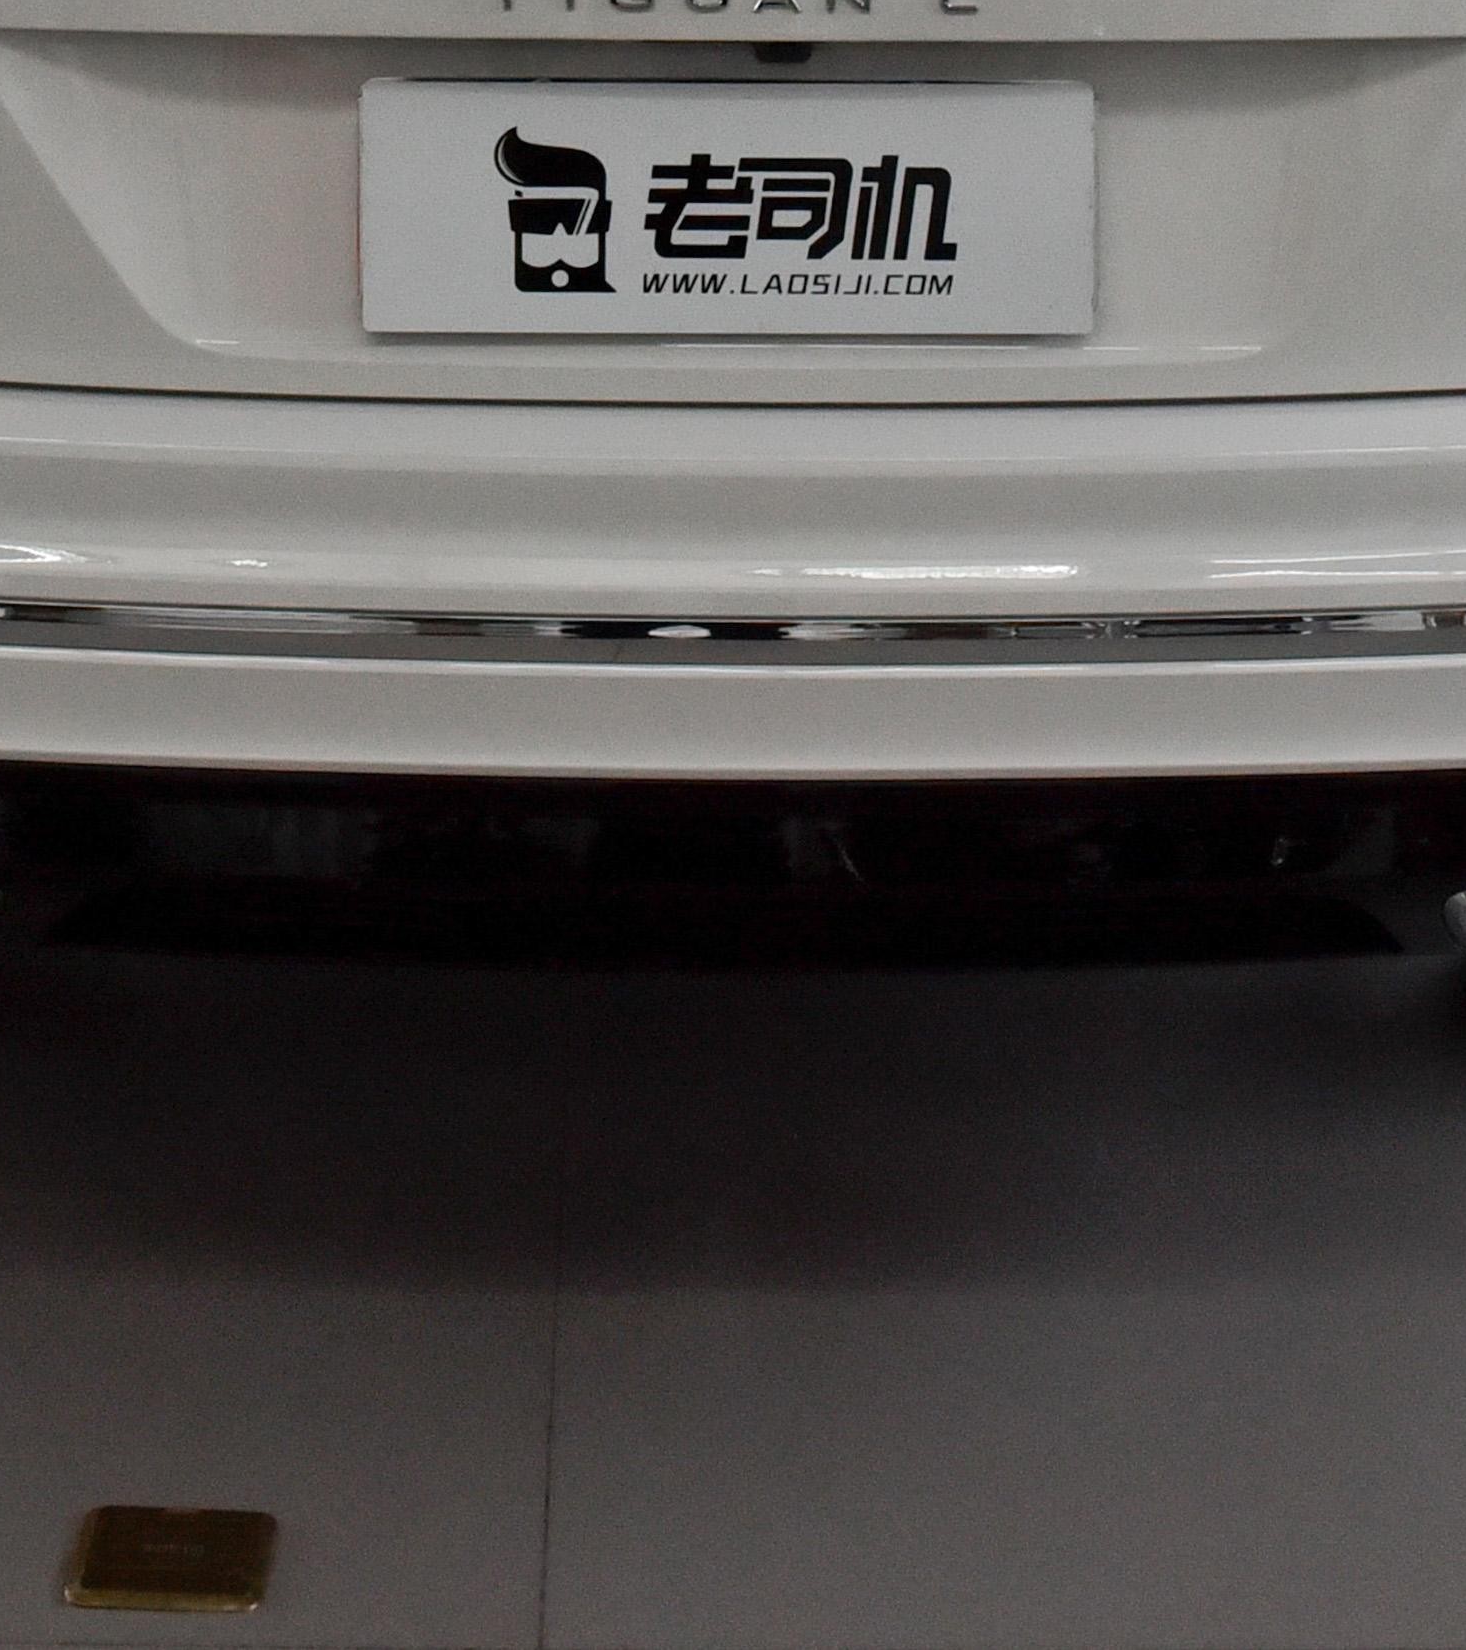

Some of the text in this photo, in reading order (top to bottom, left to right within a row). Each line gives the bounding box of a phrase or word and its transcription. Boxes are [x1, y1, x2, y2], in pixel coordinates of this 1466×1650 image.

[643, 153, 958, 261] 老司机
[641, 272, 955, 296] WWW.LAOSIJI.COM
